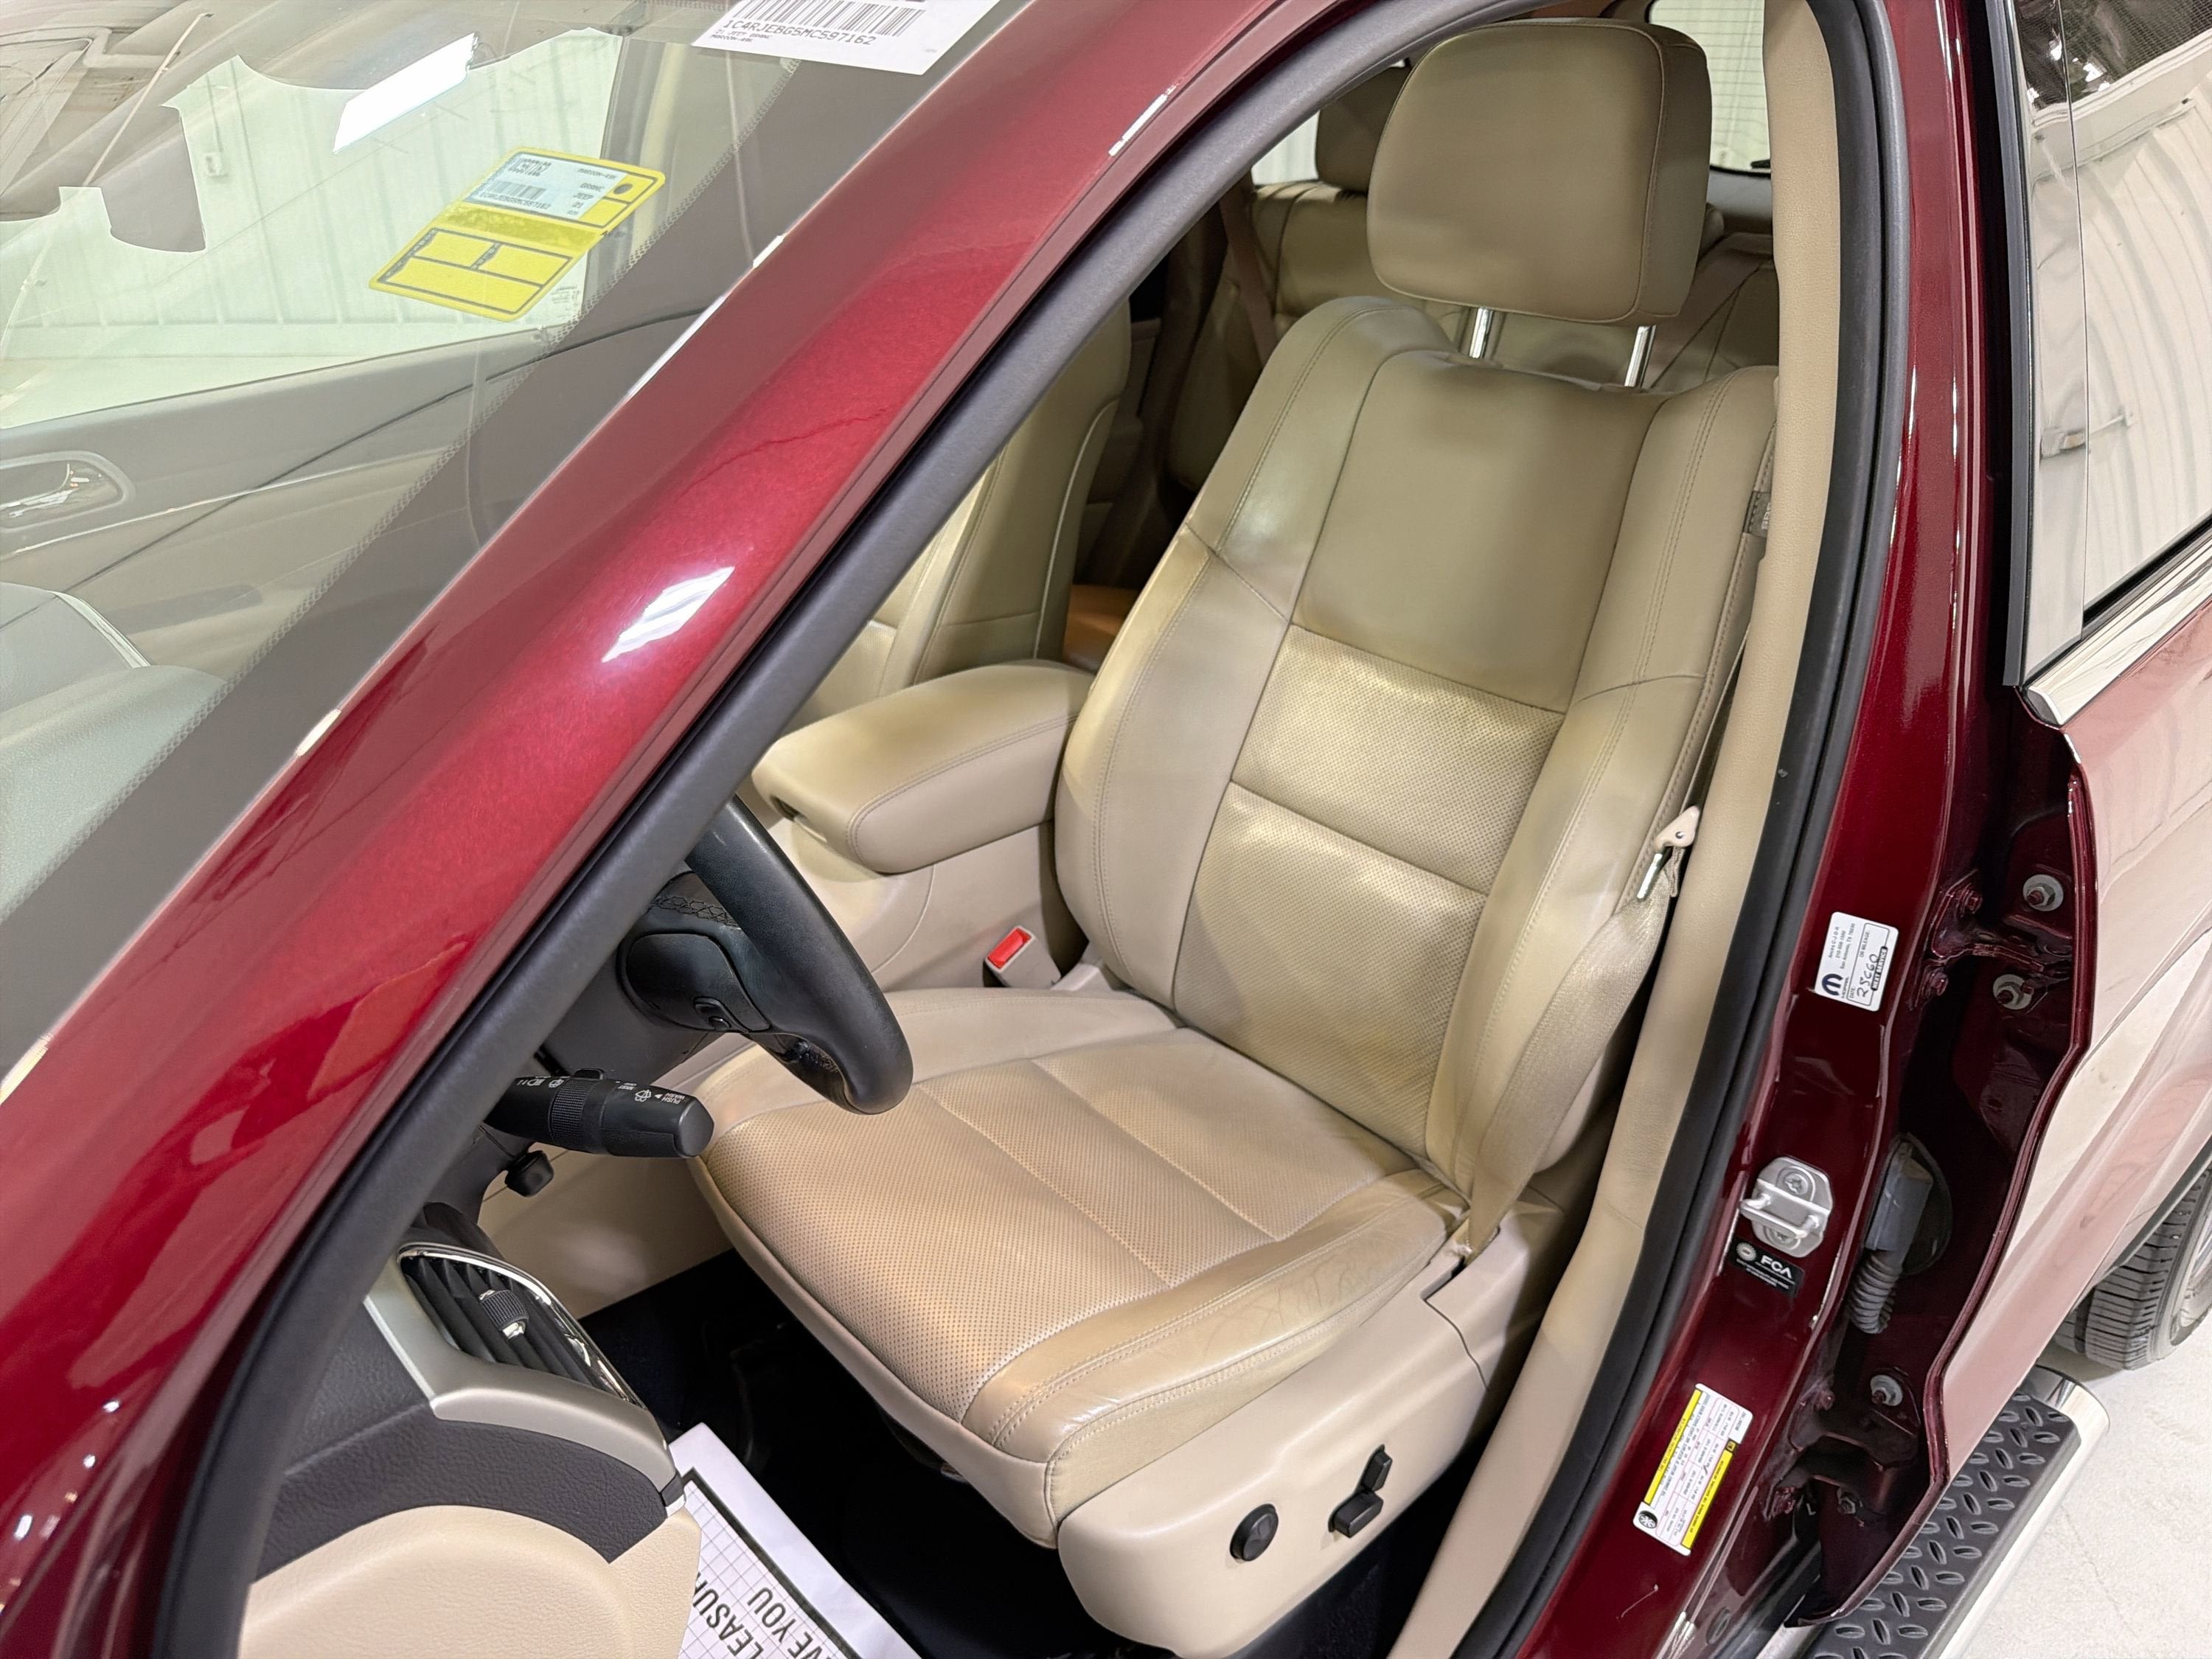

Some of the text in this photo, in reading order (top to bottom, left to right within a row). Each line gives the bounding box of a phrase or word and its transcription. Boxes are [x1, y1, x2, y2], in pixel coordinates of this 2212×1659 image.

[1877, 949, 1887, 973] SERVICE
[661, 1096, 681, 1105] PUSH
[1761, 1255, 1792, 1279] FCA
[747, 1587, 796, 1643] YOU
